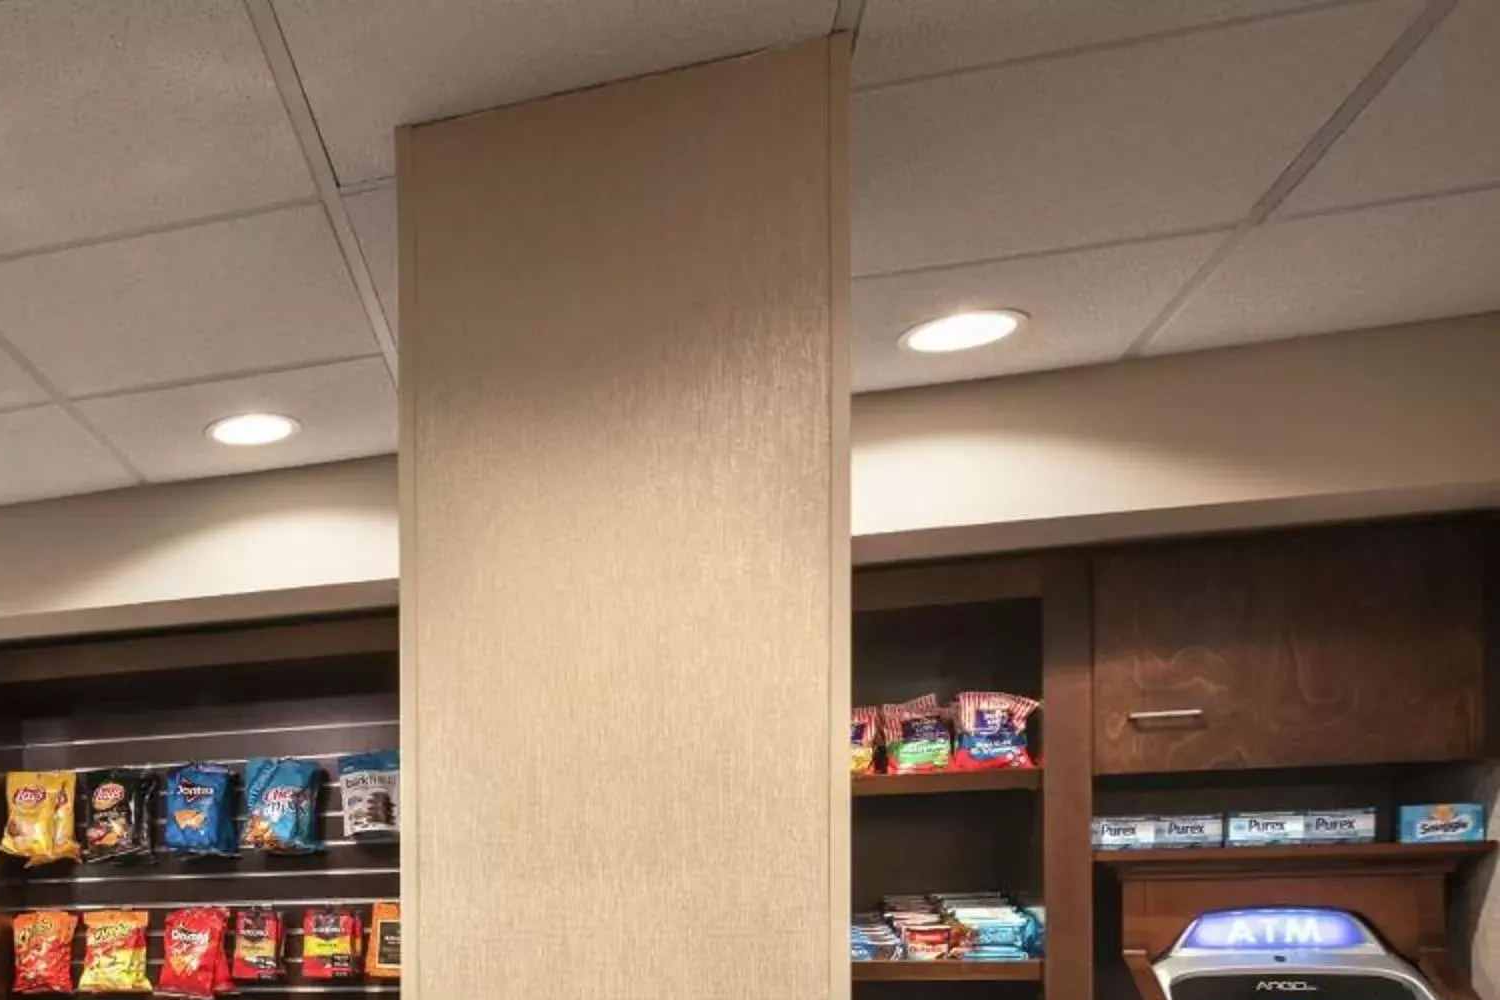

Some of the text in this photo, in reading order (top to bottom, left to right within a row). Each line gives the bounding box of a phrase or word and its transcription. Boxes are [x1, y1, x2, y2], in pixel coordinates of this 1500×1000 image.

[1101, 823, 1137, 836] Purex
[1168, 822, 1204, 835] Purex
[1248, 818, 1286, 832] Purex
[1315, 817, 1355, 831] Purex
[1227, 915, 1323, 944] ATM
